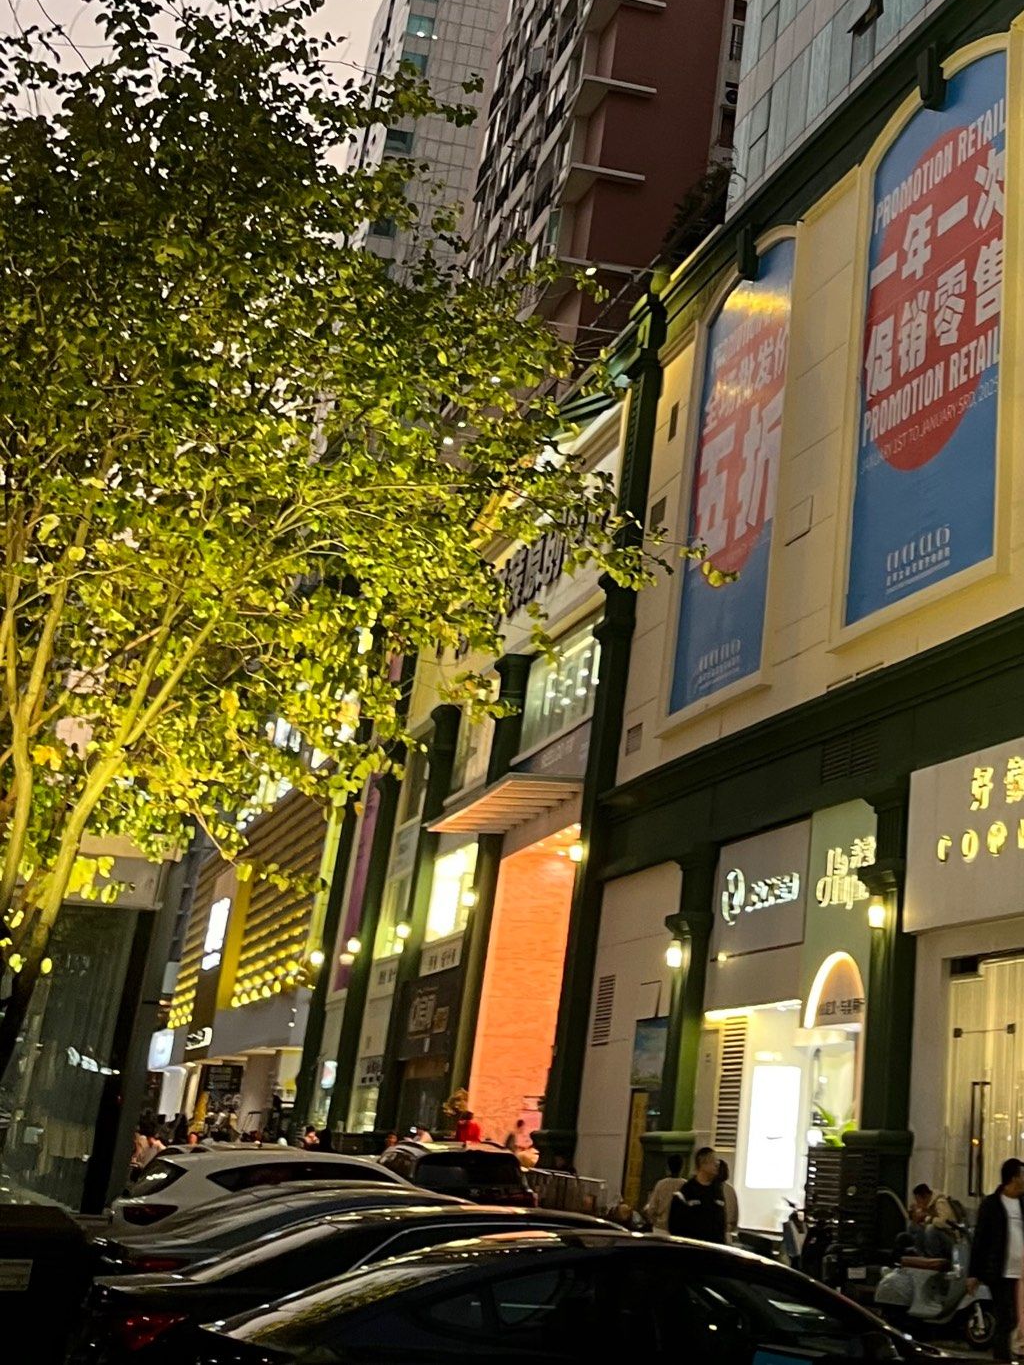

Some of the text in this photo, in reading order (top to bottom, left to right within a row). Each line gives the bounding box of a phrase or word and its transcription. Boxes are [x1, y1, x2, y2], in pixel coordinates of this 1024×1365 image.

[870, 147, 1006, 290] 一年一次
[875, 98, 1006, 234] PROMOTION RETAIL
[863, 325, 1000, 448] PROMOTION RETAIL
[865, 238, 1003, 402] 促销零售
[690, 392, 784, 572] 五折
